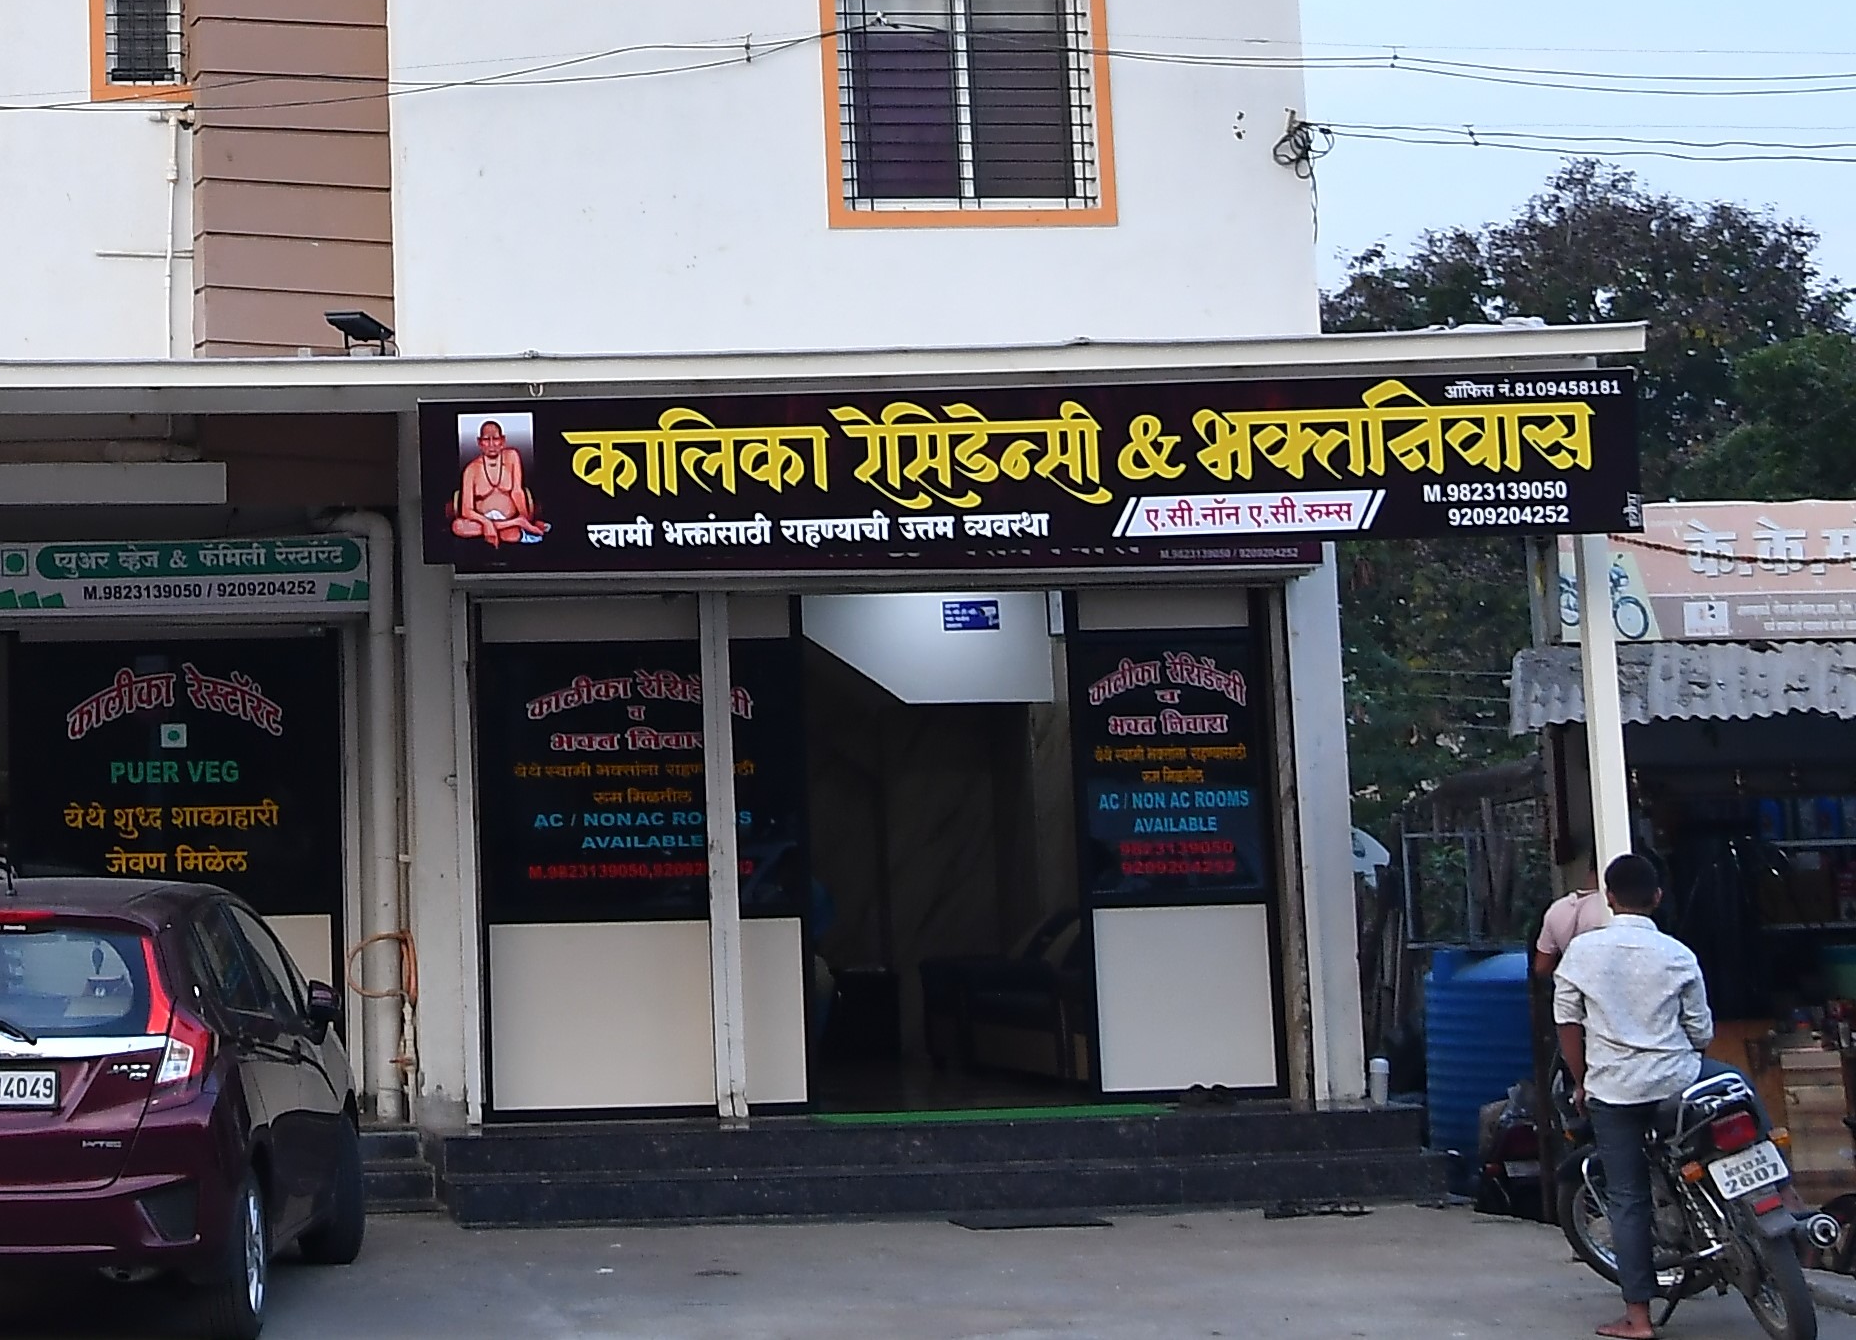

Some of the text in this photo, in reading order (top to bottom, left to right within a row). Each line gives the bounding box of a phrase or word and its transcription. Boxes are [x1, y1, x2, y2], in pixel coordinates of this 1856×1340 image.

[1444, 379, 1621, 398] ऑफिस नं.8109458181
[561, 407, 829, 498] कालिका
[828, 401, 1114, 509] रेसिडेन्सी
[1117, 415, 1187, 480] &
[1423, 481, 1568, 503] M.9823139050
[1448, 505, 1570, 525] 9209204252
[587, 510, 1050, 548] स्वामी भक्तांसाठी राहण्याची उत्तम व्यवस्था
[53, 551, 110, 579] प्युअर
[118, 544, 160, 573] व्हेज
[169, 549, 189, 569] &
[83, 579, 317, 601] M.9823139050 / 9209204252
[66, 667, 176, 741] कालीका
[110, 759, 241, 785] PUER VEG
[1099, 793, 1120, 811] AC
[1131, 791, 1167, 810] NON
[1170, 790, 1192, 808] AC
[1194, 788, 1250, 807] ROOMS
[64, 800, 106, 831] येथे
[170, 797, 280, 829] शाकाहारी
[533, 812, 565, 829] AC
[1134, 815, 1218, 834] AVAILABLE
[581, 833, 705, 850] AVAILABLE
[105, 843, 248, 876] जेवण मिळेल
